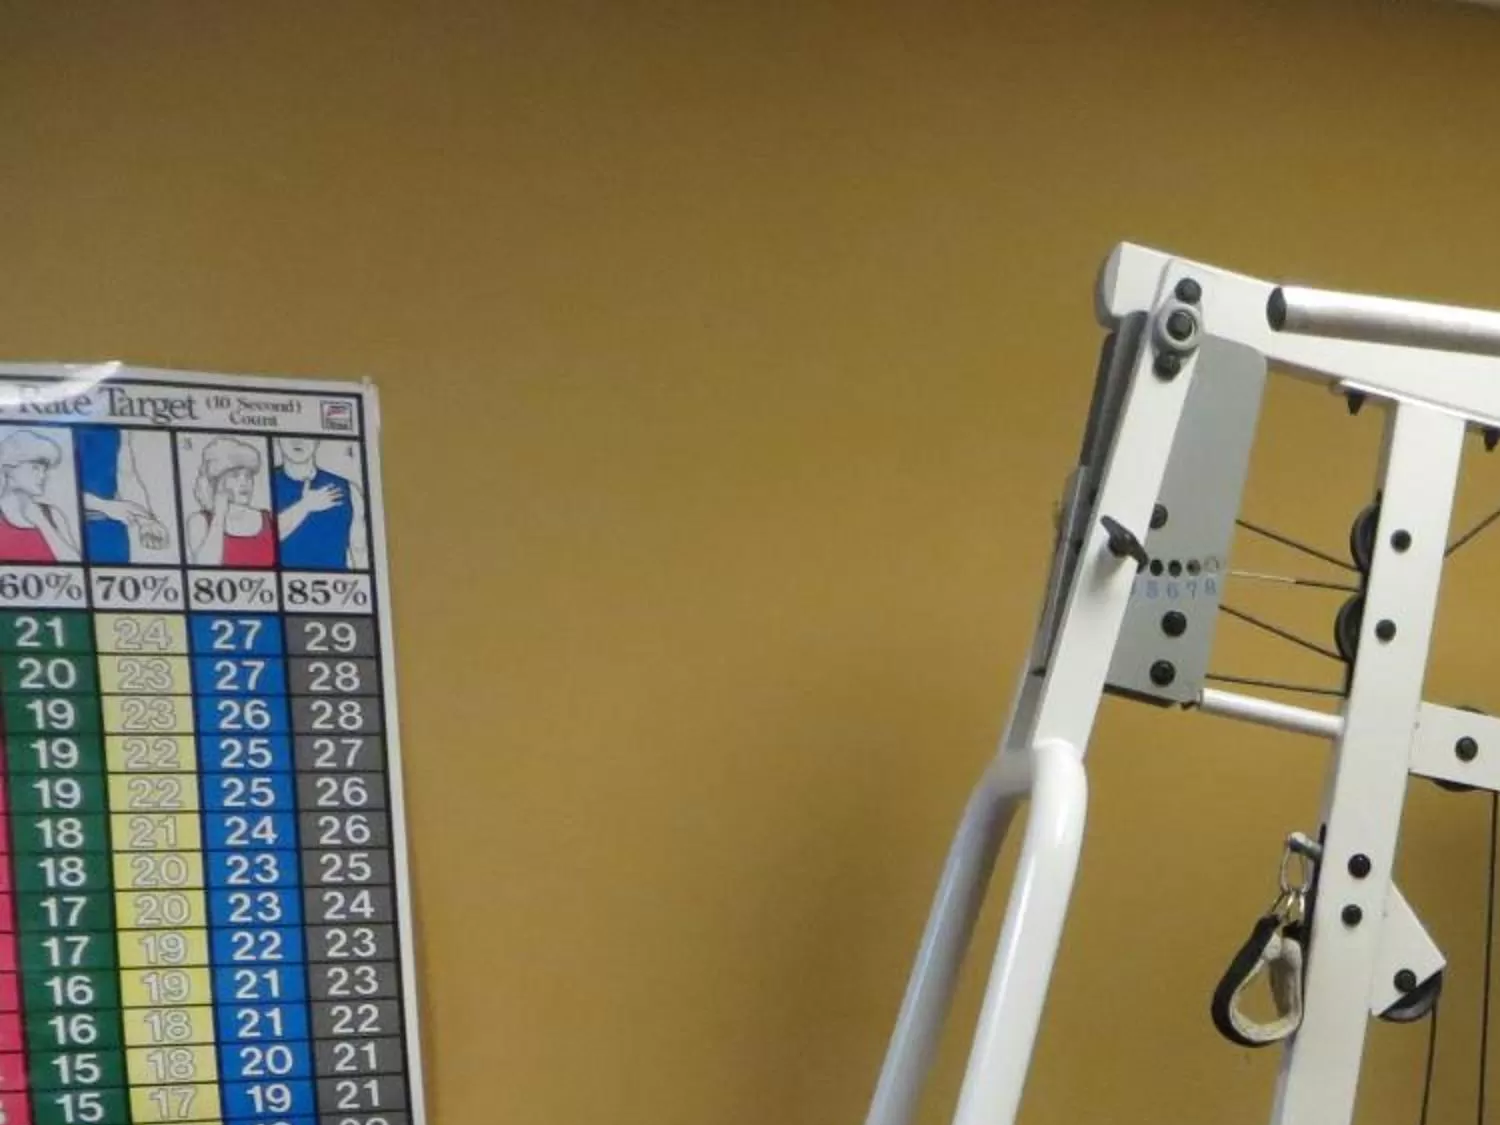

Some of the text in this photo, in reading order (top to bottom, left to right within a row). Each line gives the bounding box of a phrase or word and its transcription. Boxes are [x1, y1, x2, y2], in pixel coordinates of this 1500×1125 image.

[98, 385, 199, 425] Target
[228, 413, 278, 427] Count
[0, 573, 367, 606] 60% 70% 80% 85%
[15, 615, 357, 653] 21 24 27 29
[18, 657, 361, 692] 20 23 27 28
[27, 698, 364, 731] 19 23 26 28
[31, 737, 363, 770] 19 22 25 27
[33, 776, 368, 809] 19 22 25 26
[35, 814, 371, 849] 18 21 24 26
[38, 852, 372, 887] 18 20 23 25
[40, 889, 375, 927] 17 20 23 24
[42, 927, 377, 967] 17 19 22 23
[45, 965, 379, 1006] 16 19 21 23
[48, 1003, 381, 1045] 16 18 21 22
[52, 1041, 377, 1085] 15 18 20 21
[55, 1079, 380, 1123] 15 17 19 21
